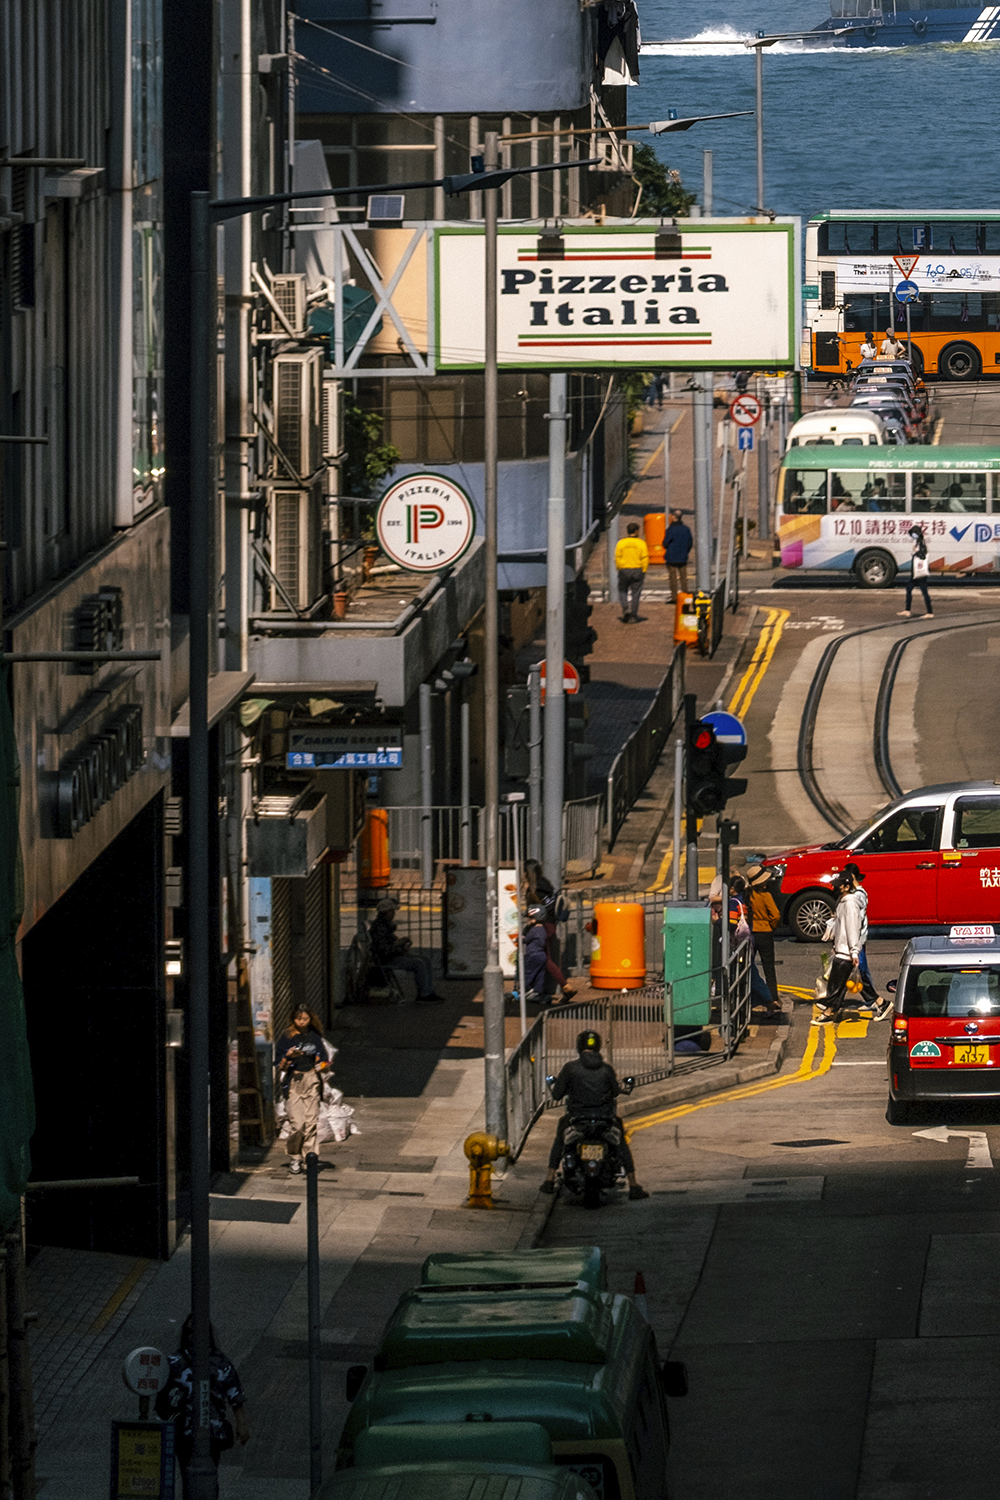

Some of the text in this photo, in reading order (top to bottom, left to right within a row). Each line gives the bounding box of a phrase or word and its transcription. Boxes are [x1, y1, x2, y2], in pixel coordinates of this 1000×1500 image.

[500, 266, 729, 294] Pizzeria
[529, 299, 700, 326] Italia
[398, 486, 451, 502] PIZZERIA
[834, 519, 947, 536] 12.10 請投票支持
[405, 549, 446, 561] ITALIA
[304, 737, 348, 745] DAIKIN
[953, 927, 991, 935] TAXI
[959, 1053, 985, 1063] 4137
